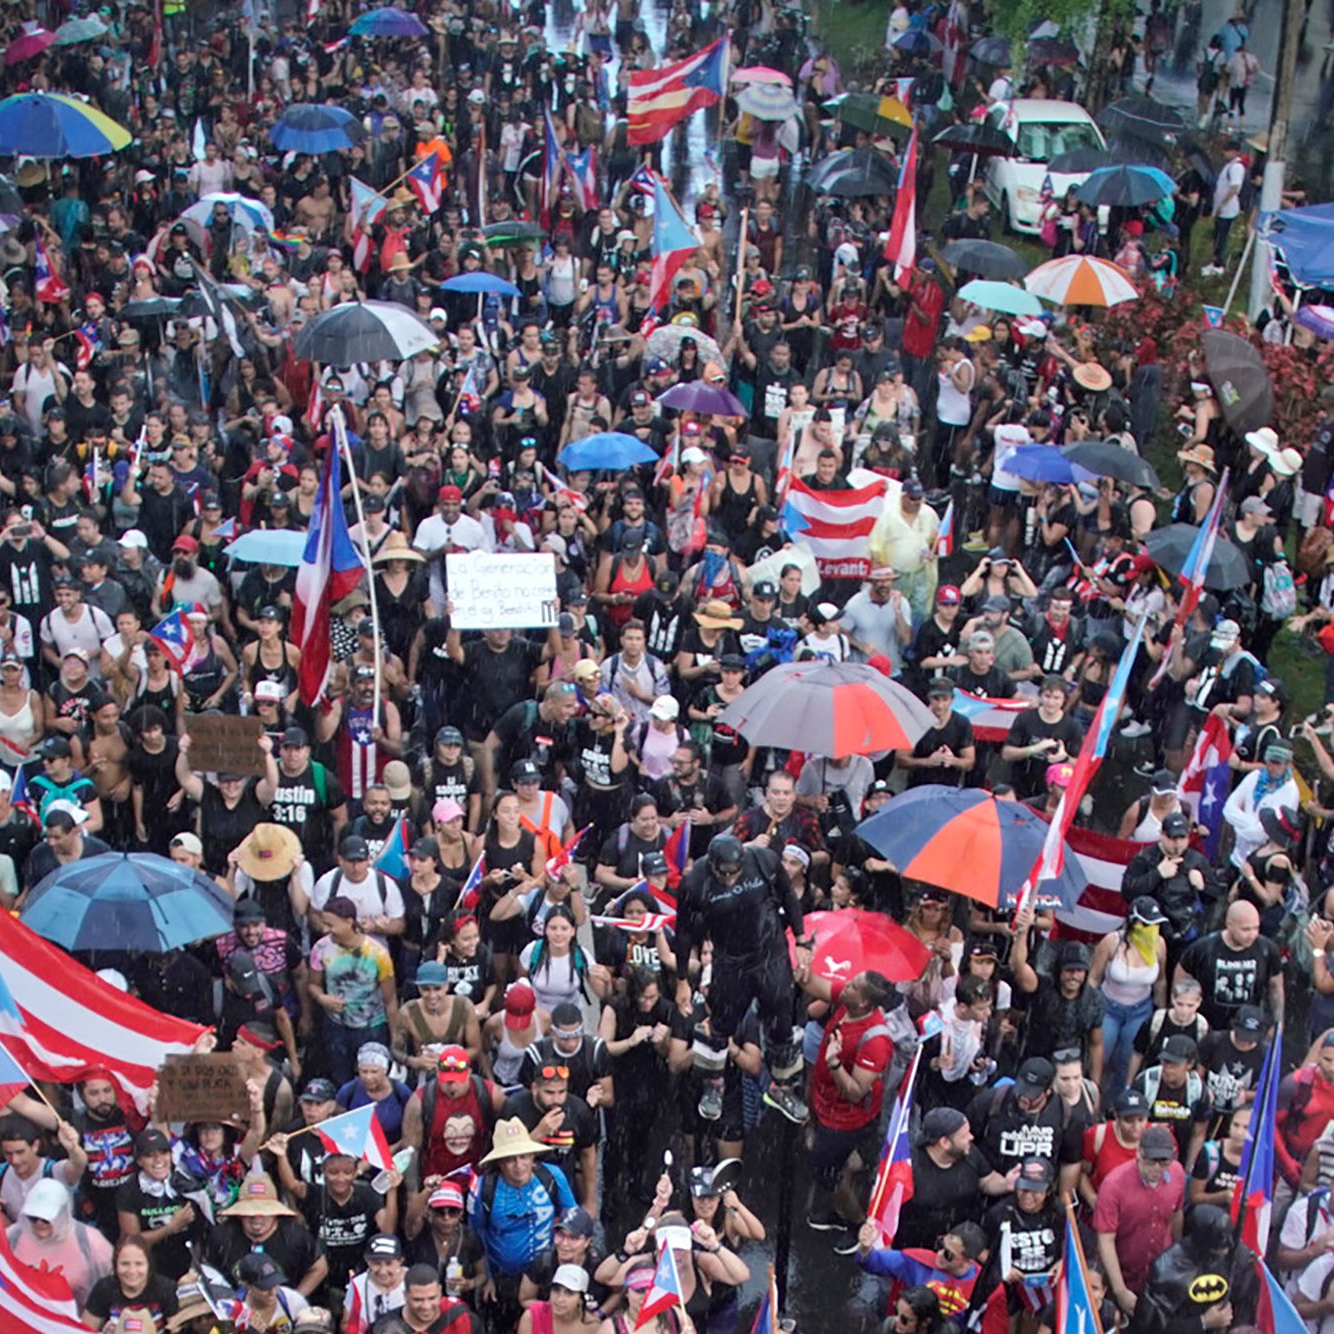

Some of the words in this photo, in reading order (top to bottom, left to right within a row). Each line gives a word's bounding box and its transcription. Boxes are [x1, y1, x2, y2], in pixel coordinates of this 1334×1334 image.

[818, 560, 868, 575] Levant
[274, 785, 316, 804] ustin
[271, 804, 307, 823] 3:16
[1006, 893, 1063, 906] NTICA
[628, 945, 661, 965] OVE
[1000, 1138, 1053, 1157] UPR
